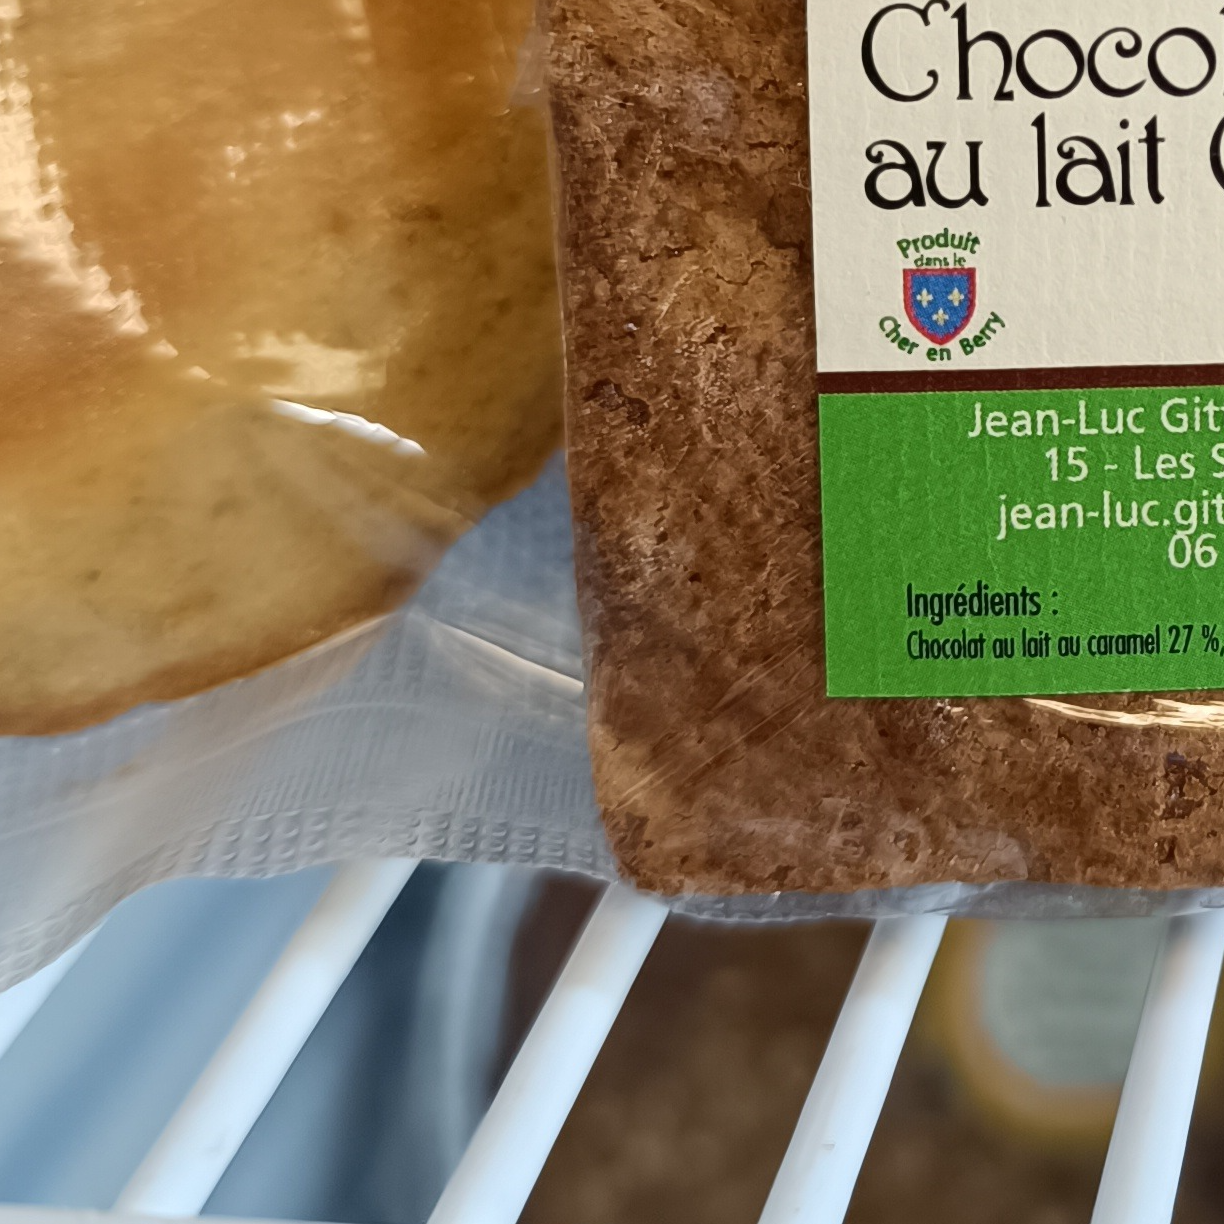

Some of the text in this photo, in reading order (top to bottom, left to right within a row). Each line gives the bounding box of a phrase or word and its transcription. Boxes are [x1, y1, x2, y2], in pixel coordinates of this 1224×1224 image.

[863, 137, 990, 210] au
[1034, 112, 1167, 208] lait
[896, 227, 981, 259] Produit
[878, 311, 1006, 362] Cher en Berry
[968, 399, 1147, 439] Jean-Luc
[1045, 446, 1089, 482] 15
[1134, 445, 1196, 480] Les
[1167, 532, 1219, 569] 06
[906, 579, 1042, 626] Ingrédients
[906, 628, 986, 660] Chocolat
[992, 640, 1015, 658] au
[1021, 627, 1051, 658] lait
[1057, 638, 1081, 657] au
[1087, 624, 1161, 656] caramel
[1167, 624, 1195, 654] 27
